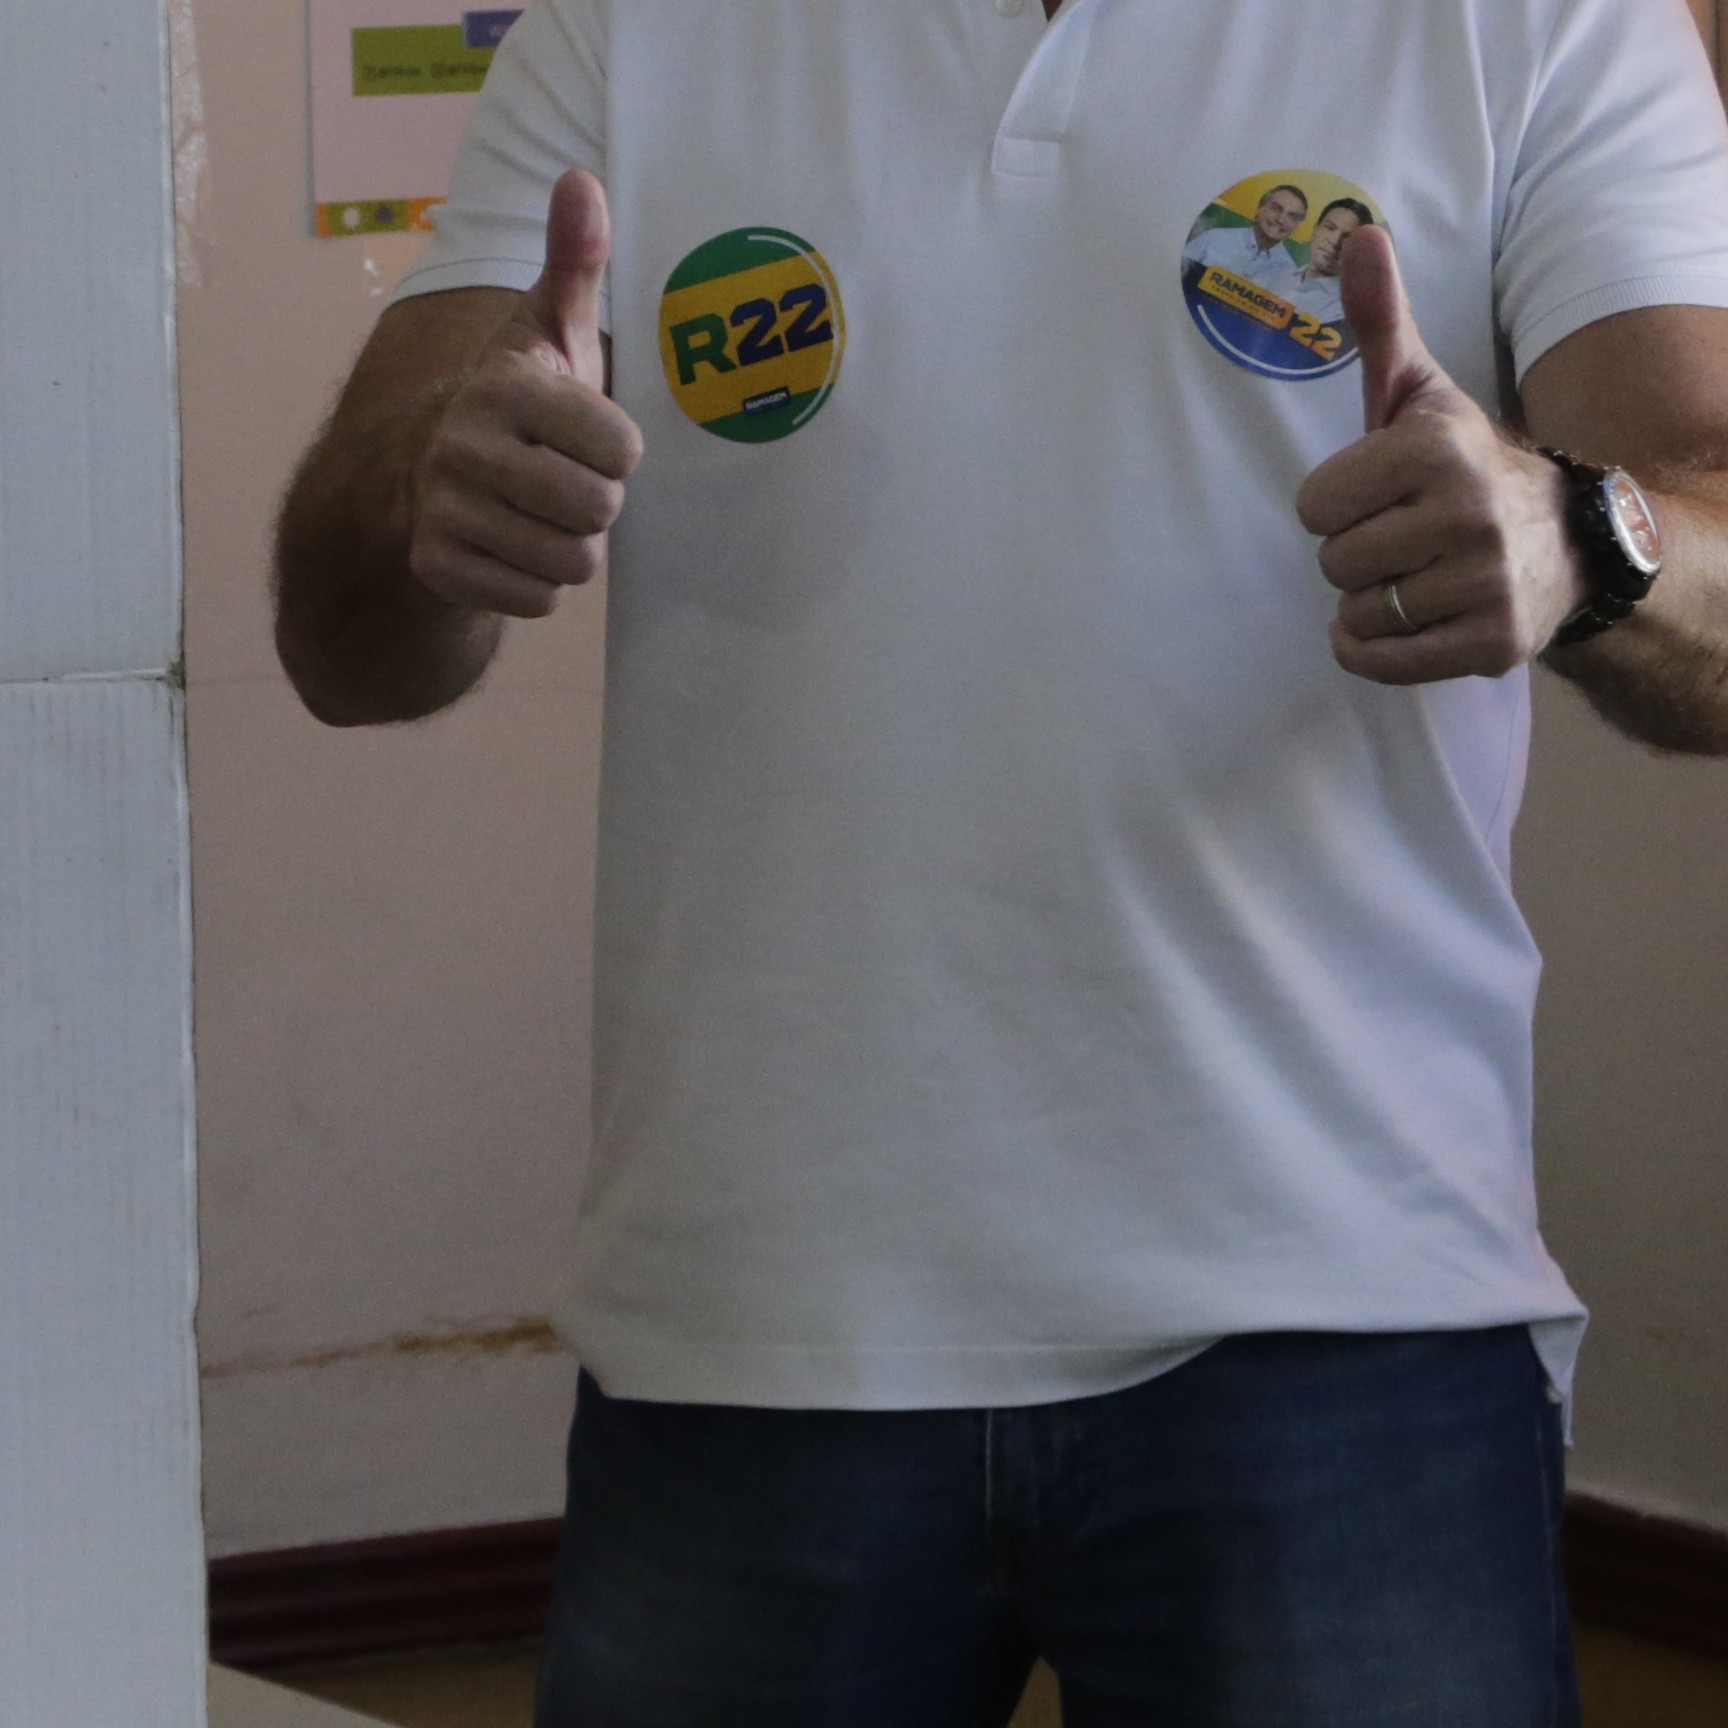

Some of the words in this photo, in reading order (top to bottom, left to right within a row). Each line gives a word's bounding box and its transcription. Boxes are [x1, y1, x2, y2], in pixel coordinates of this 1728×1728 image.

[1209, 271, 1286, 318] RAMAGEM
[669, 283, 834, 386] R22
[1289, 313, 1342, 361] 22
